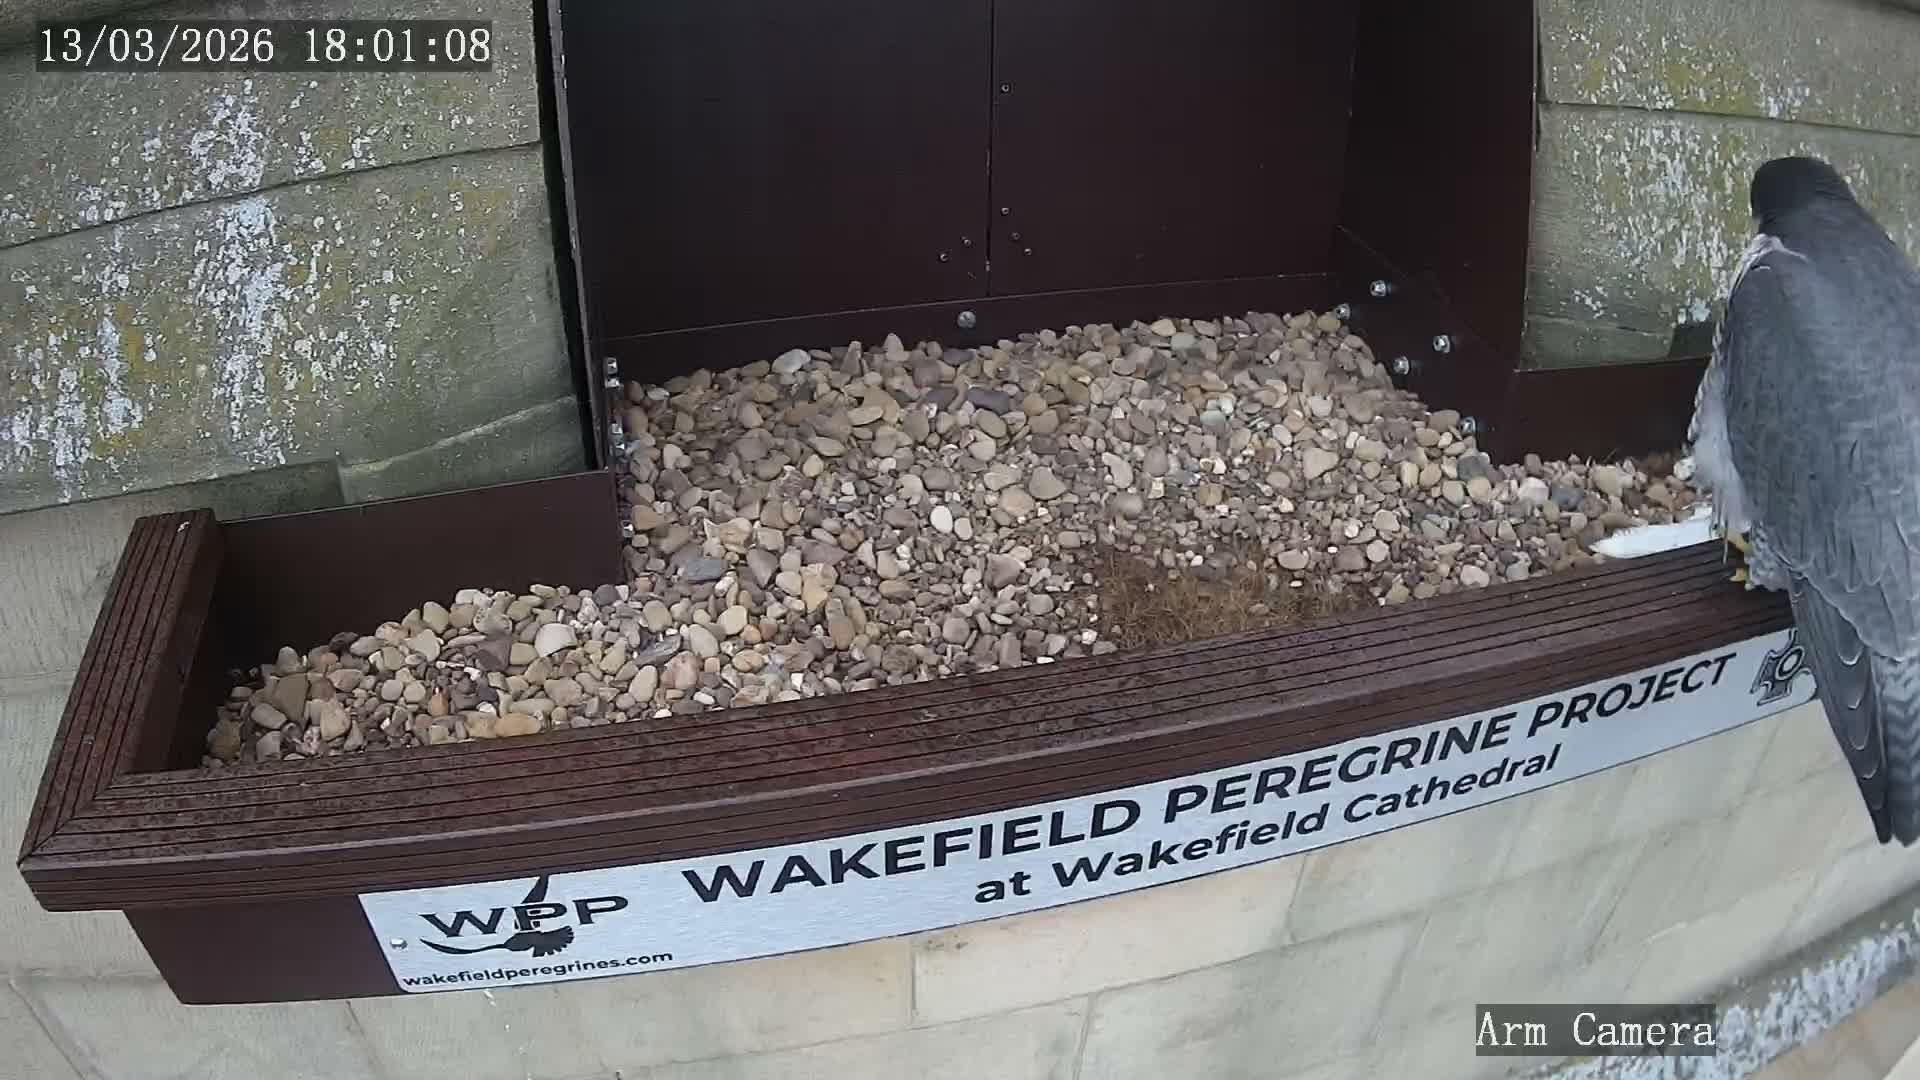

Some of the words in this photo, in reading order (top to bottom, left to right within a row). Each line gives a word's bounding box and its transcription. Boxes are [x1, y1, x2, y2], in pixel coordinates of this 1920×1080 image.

[682, 799, 1141, 903] WAKEFIELD
[1163, 711, 1518, 823] PEREGRINE
[1527, 653, 1736, 737] PROJECT
[975, 871, 1031, 904] at
[1052, 805, 1328, 888] Wakefield
[1343, 743, 1562, 823] Cathedral
[418, 895, 629, 938] WPP
[403, 951, 673, 987] wakefieldperegrines.com
